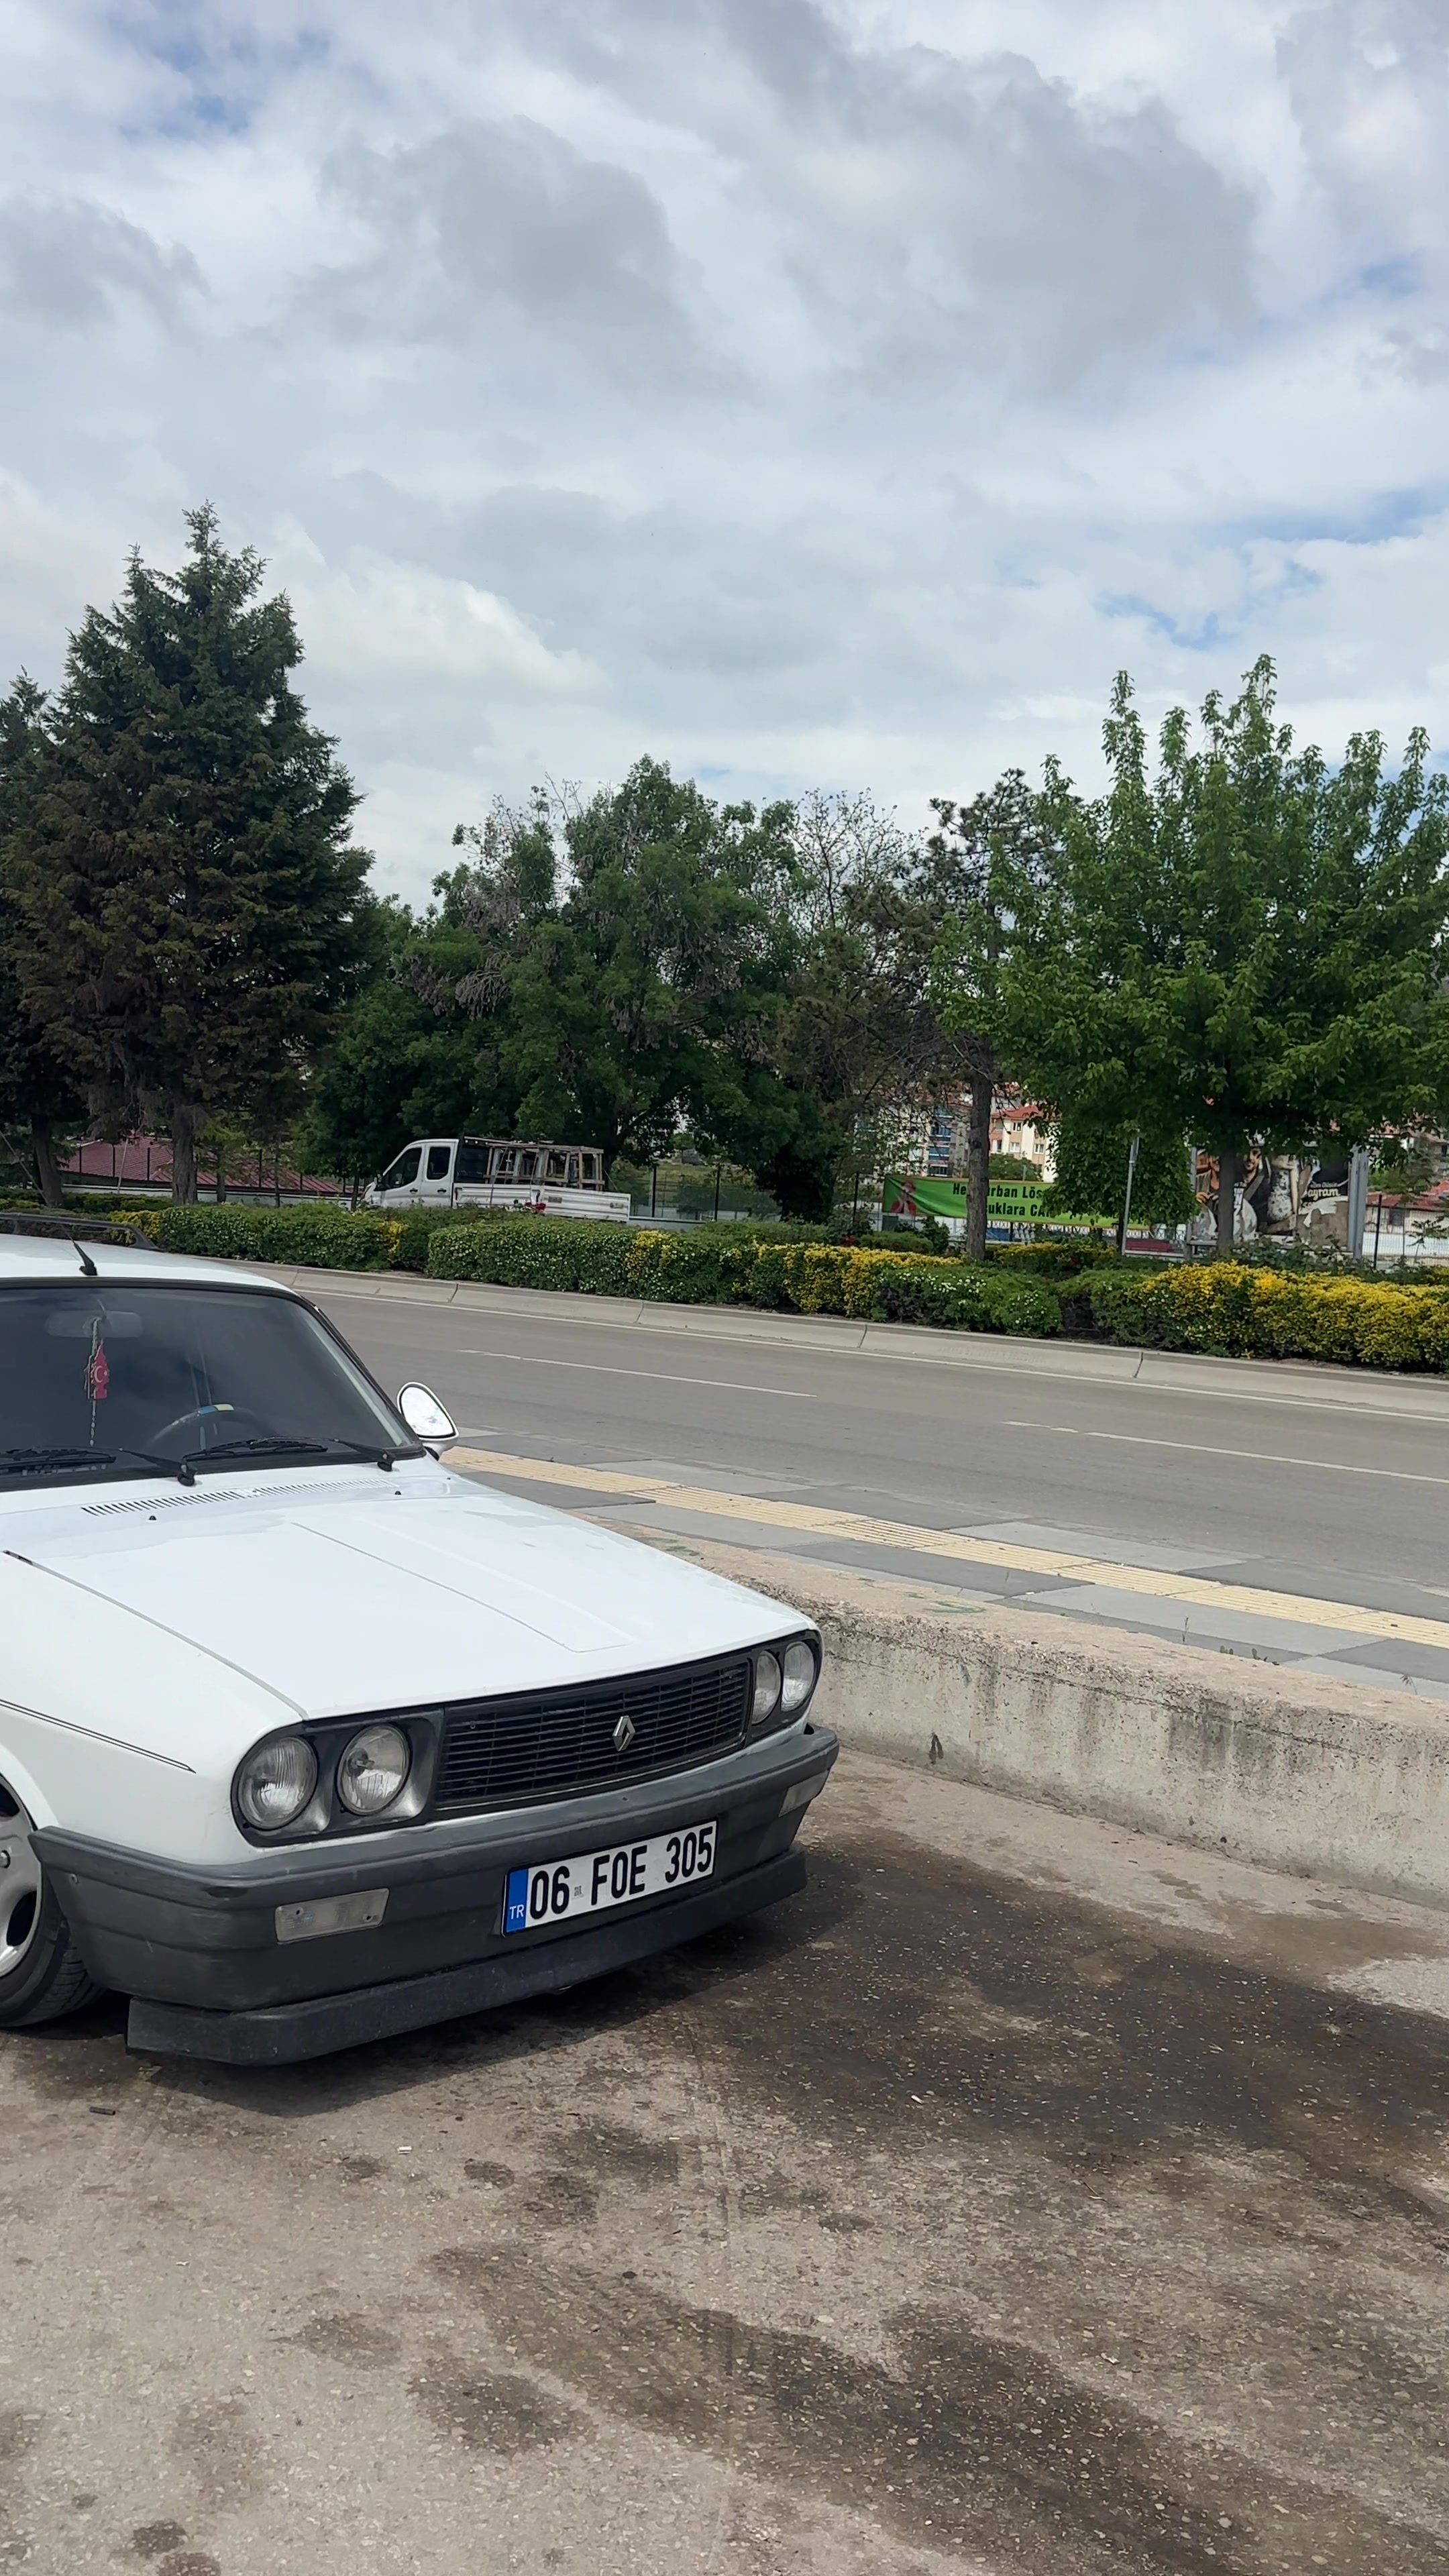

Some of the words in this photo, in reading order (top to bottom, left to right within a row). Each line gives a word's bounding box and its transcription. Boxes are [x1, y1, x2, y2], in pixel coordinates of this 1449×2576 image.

[953, 1183, 967, 1195] He
[985, 1202, 1026, 1216] uklara
[1030, 1204, 1049, 1218] CA
[510, 1904, 525, 1920] TR
[529, 1866, 570, 1919] 06
[590, 1844, 648, 1906] FOE
[665, 1825, 714, 1884] 305
